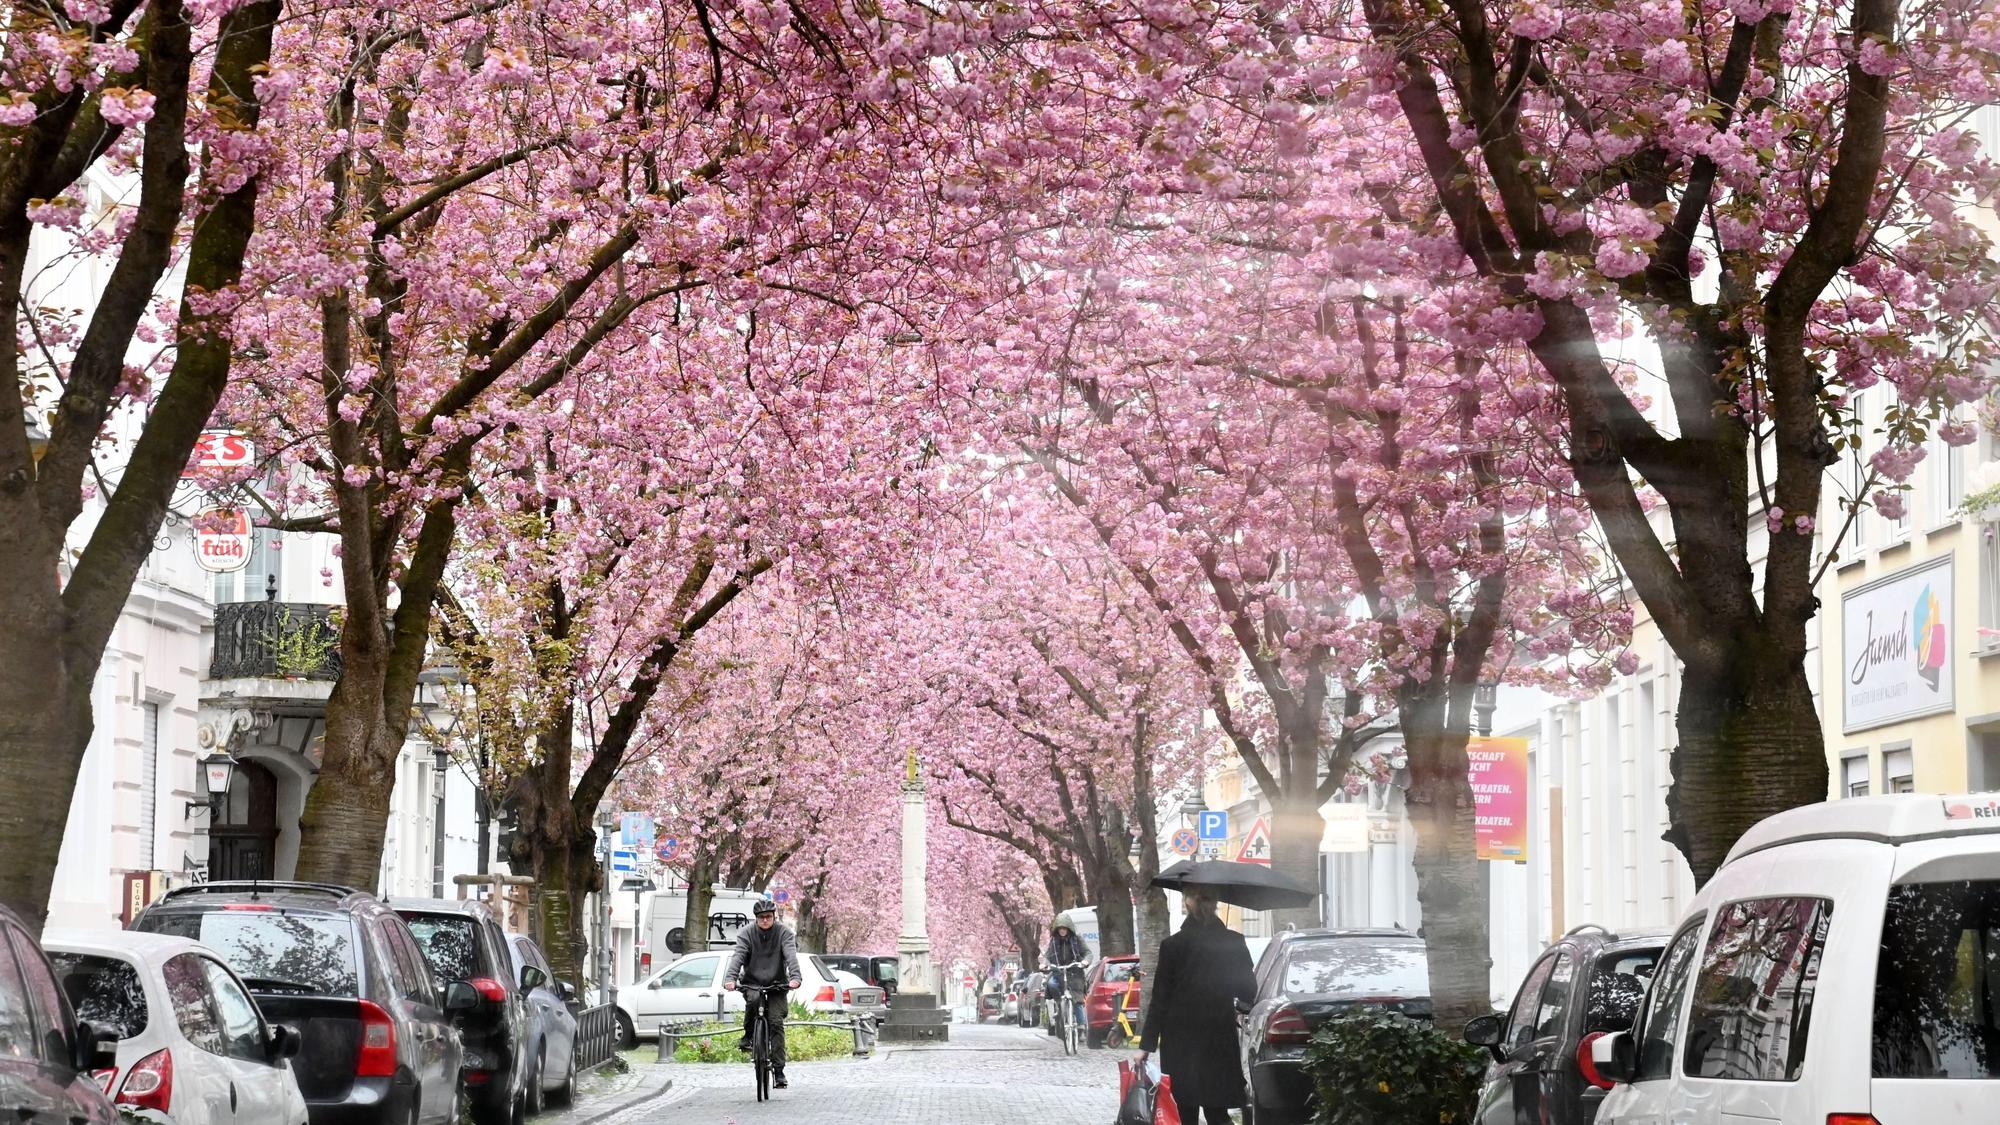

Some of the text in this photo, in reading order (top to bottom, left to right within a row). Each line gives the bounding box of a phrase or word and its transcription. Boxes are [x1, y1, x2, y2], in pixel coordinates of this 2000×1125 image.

[202, 539, 243, 559] früh
[1851, 610, 1907, 685] Jaensch
[1206, 815, 1220, 836] P
